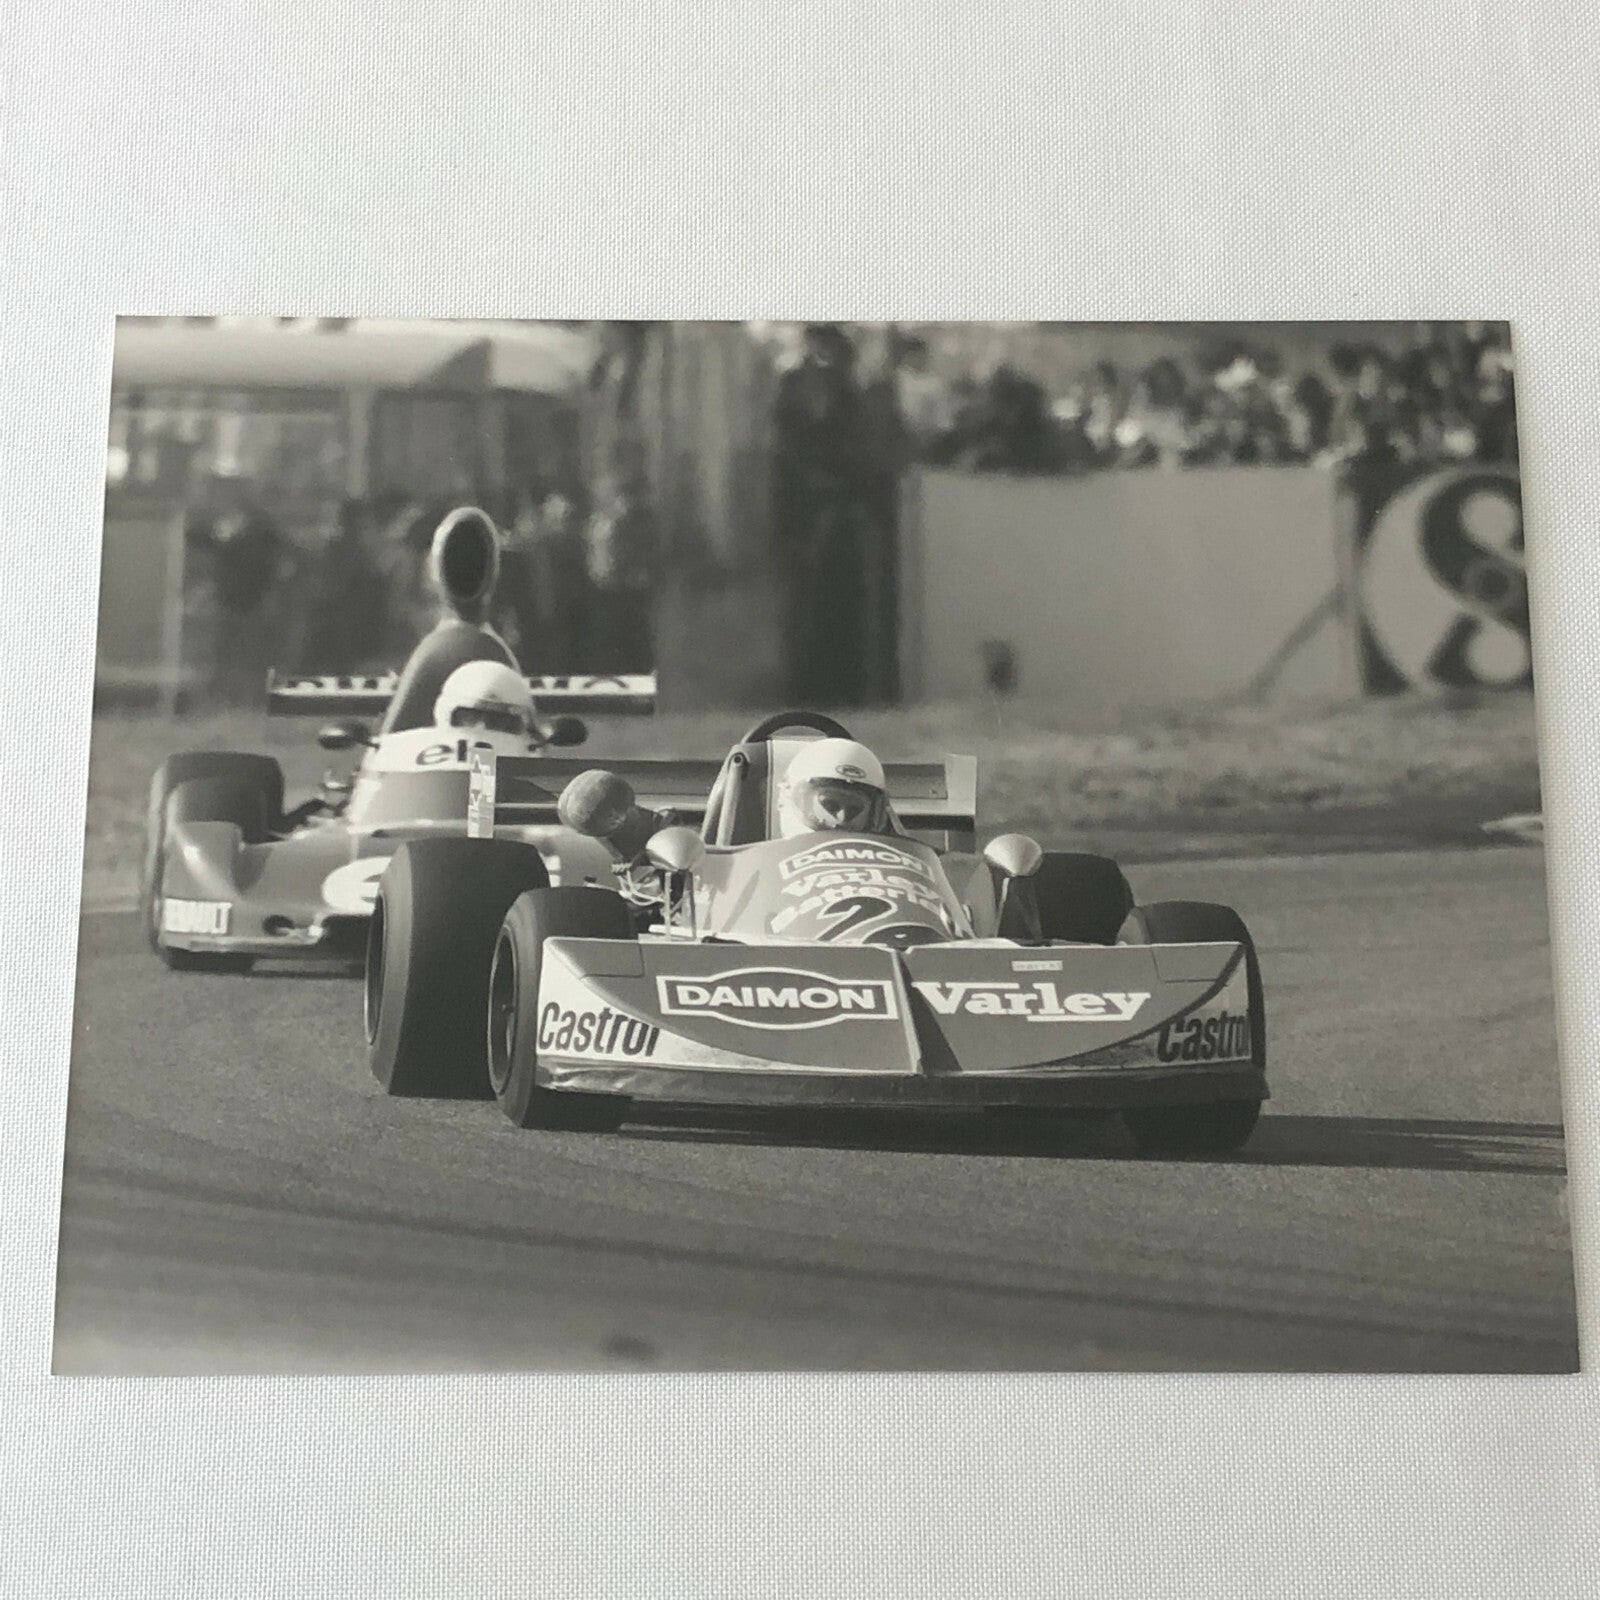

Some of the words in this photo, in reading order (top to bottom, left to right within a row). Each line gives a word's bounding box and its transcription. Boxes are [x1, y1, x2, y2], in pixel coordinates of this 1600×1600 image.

[416, 738, 493, 766] el
[793, 848, 923, 870] DAIMON
[781, 867, 941, 900] Varley
[816, 895, 898, 942] 2
[676, 985, 876, 1010] DAIMON
[912, 982, 1151, 1022] Varley
[538, 1001, 660, 1057] Castrol
[1158, 1010, 1251, 1062] Castro
